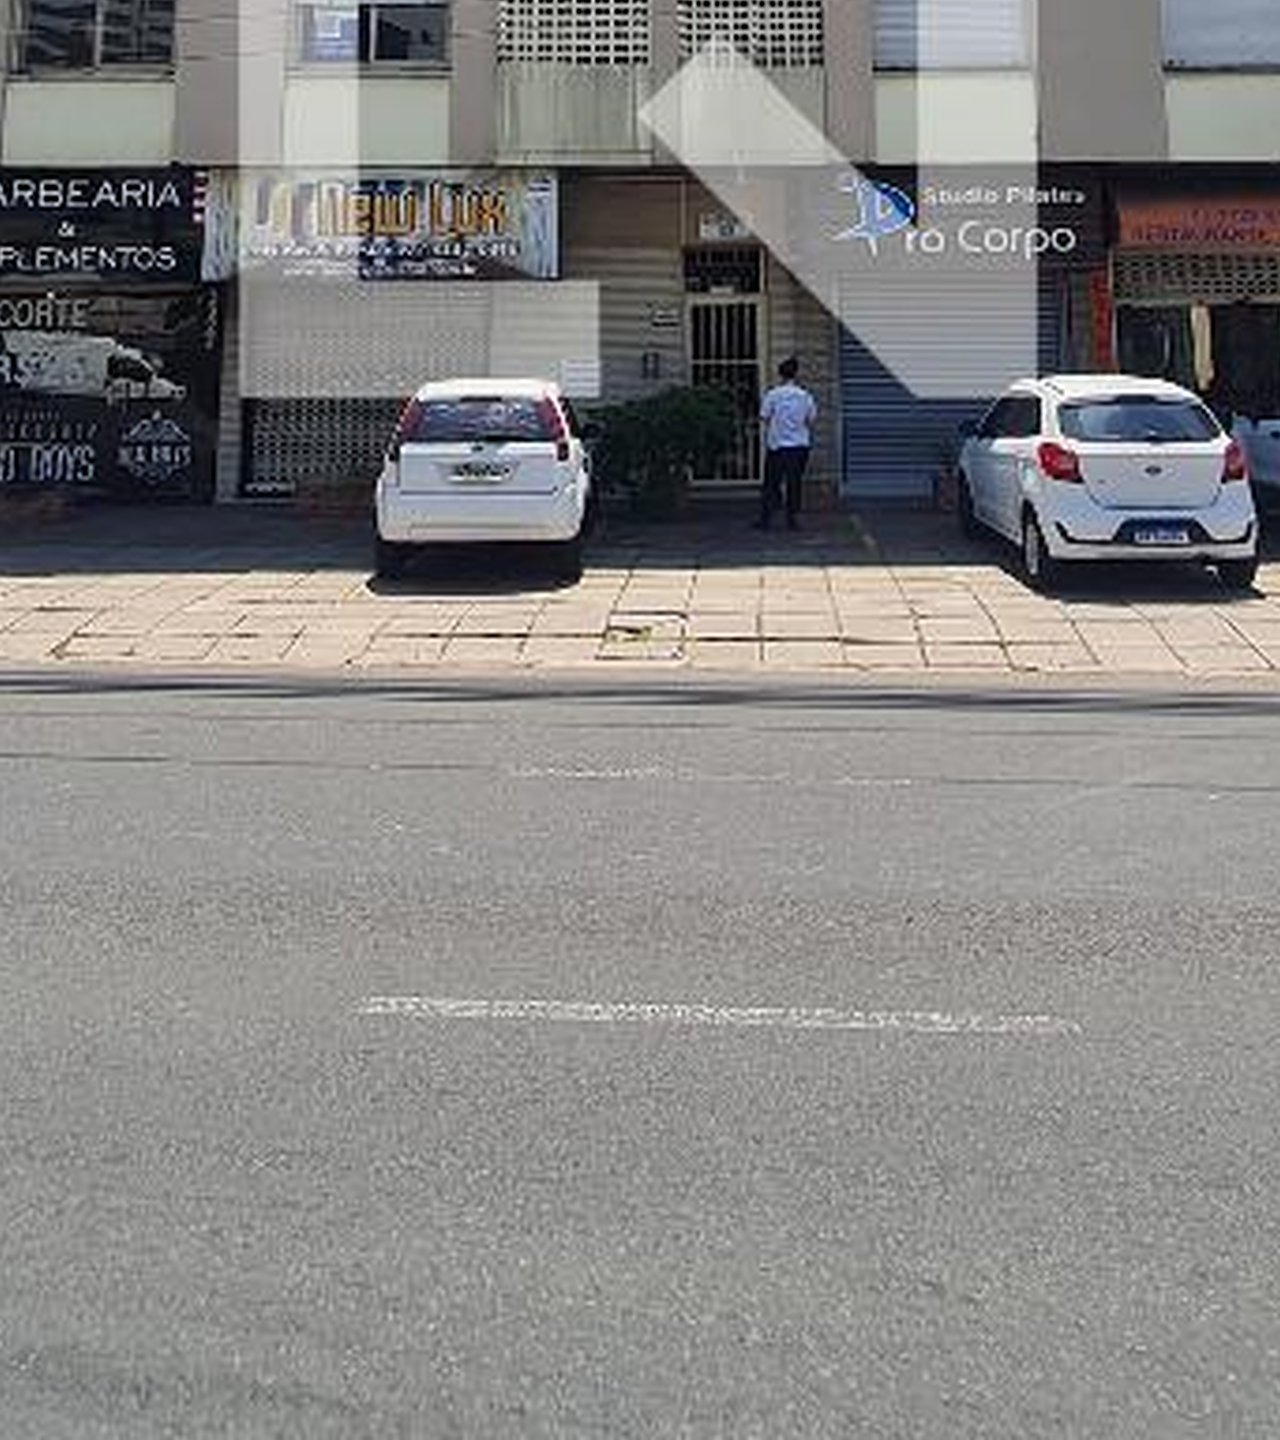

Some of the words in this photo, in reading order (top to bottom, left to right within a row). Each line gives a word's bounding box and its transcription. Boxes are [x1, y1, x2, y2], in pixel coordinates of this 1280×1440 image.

[922, 187, 1001, 205] Studio
[58, 221, 76, 238] &
[958, 220, 1077, 261] Corpo
